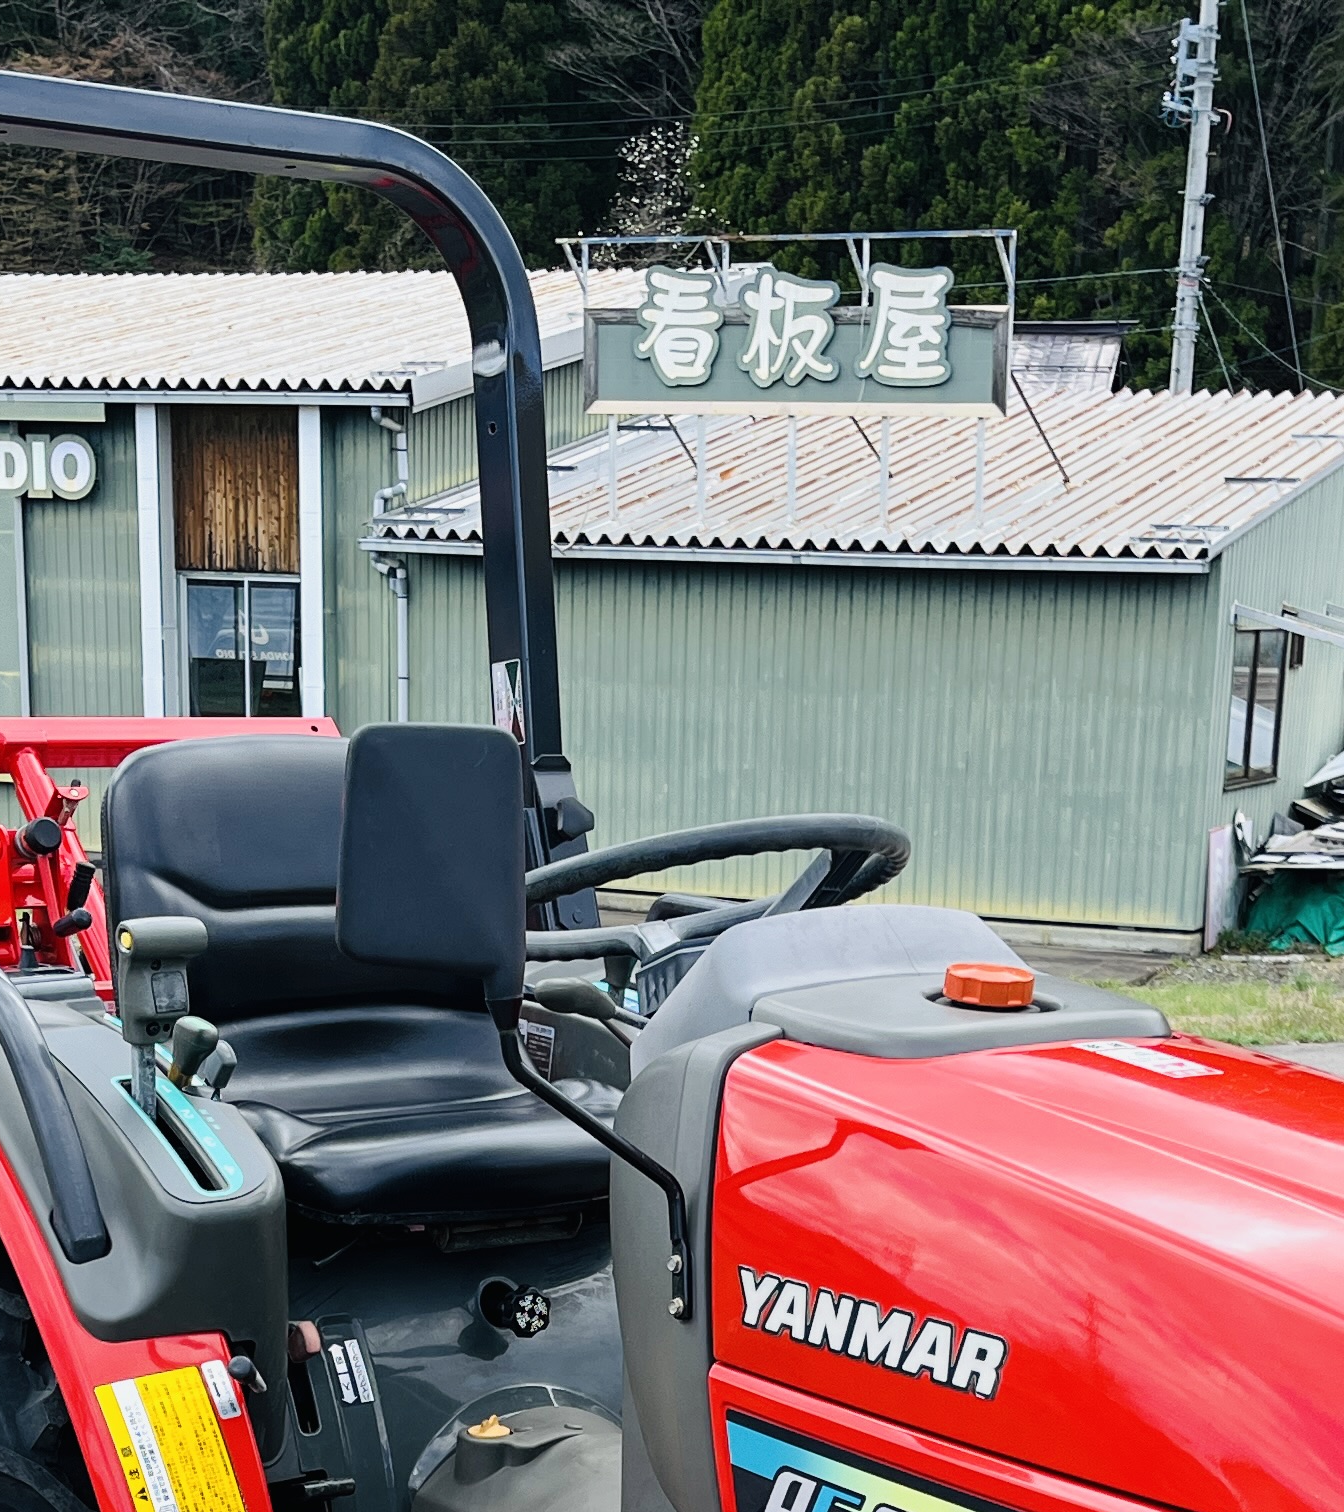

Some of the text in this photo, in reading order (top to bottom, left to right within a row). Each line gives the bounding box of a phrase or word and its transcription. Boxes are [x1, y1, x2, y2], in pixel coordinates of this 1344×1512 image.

[637, 266, 951, 383] 看板屋
[739, 1266, 1008, 1401] YANMAR
